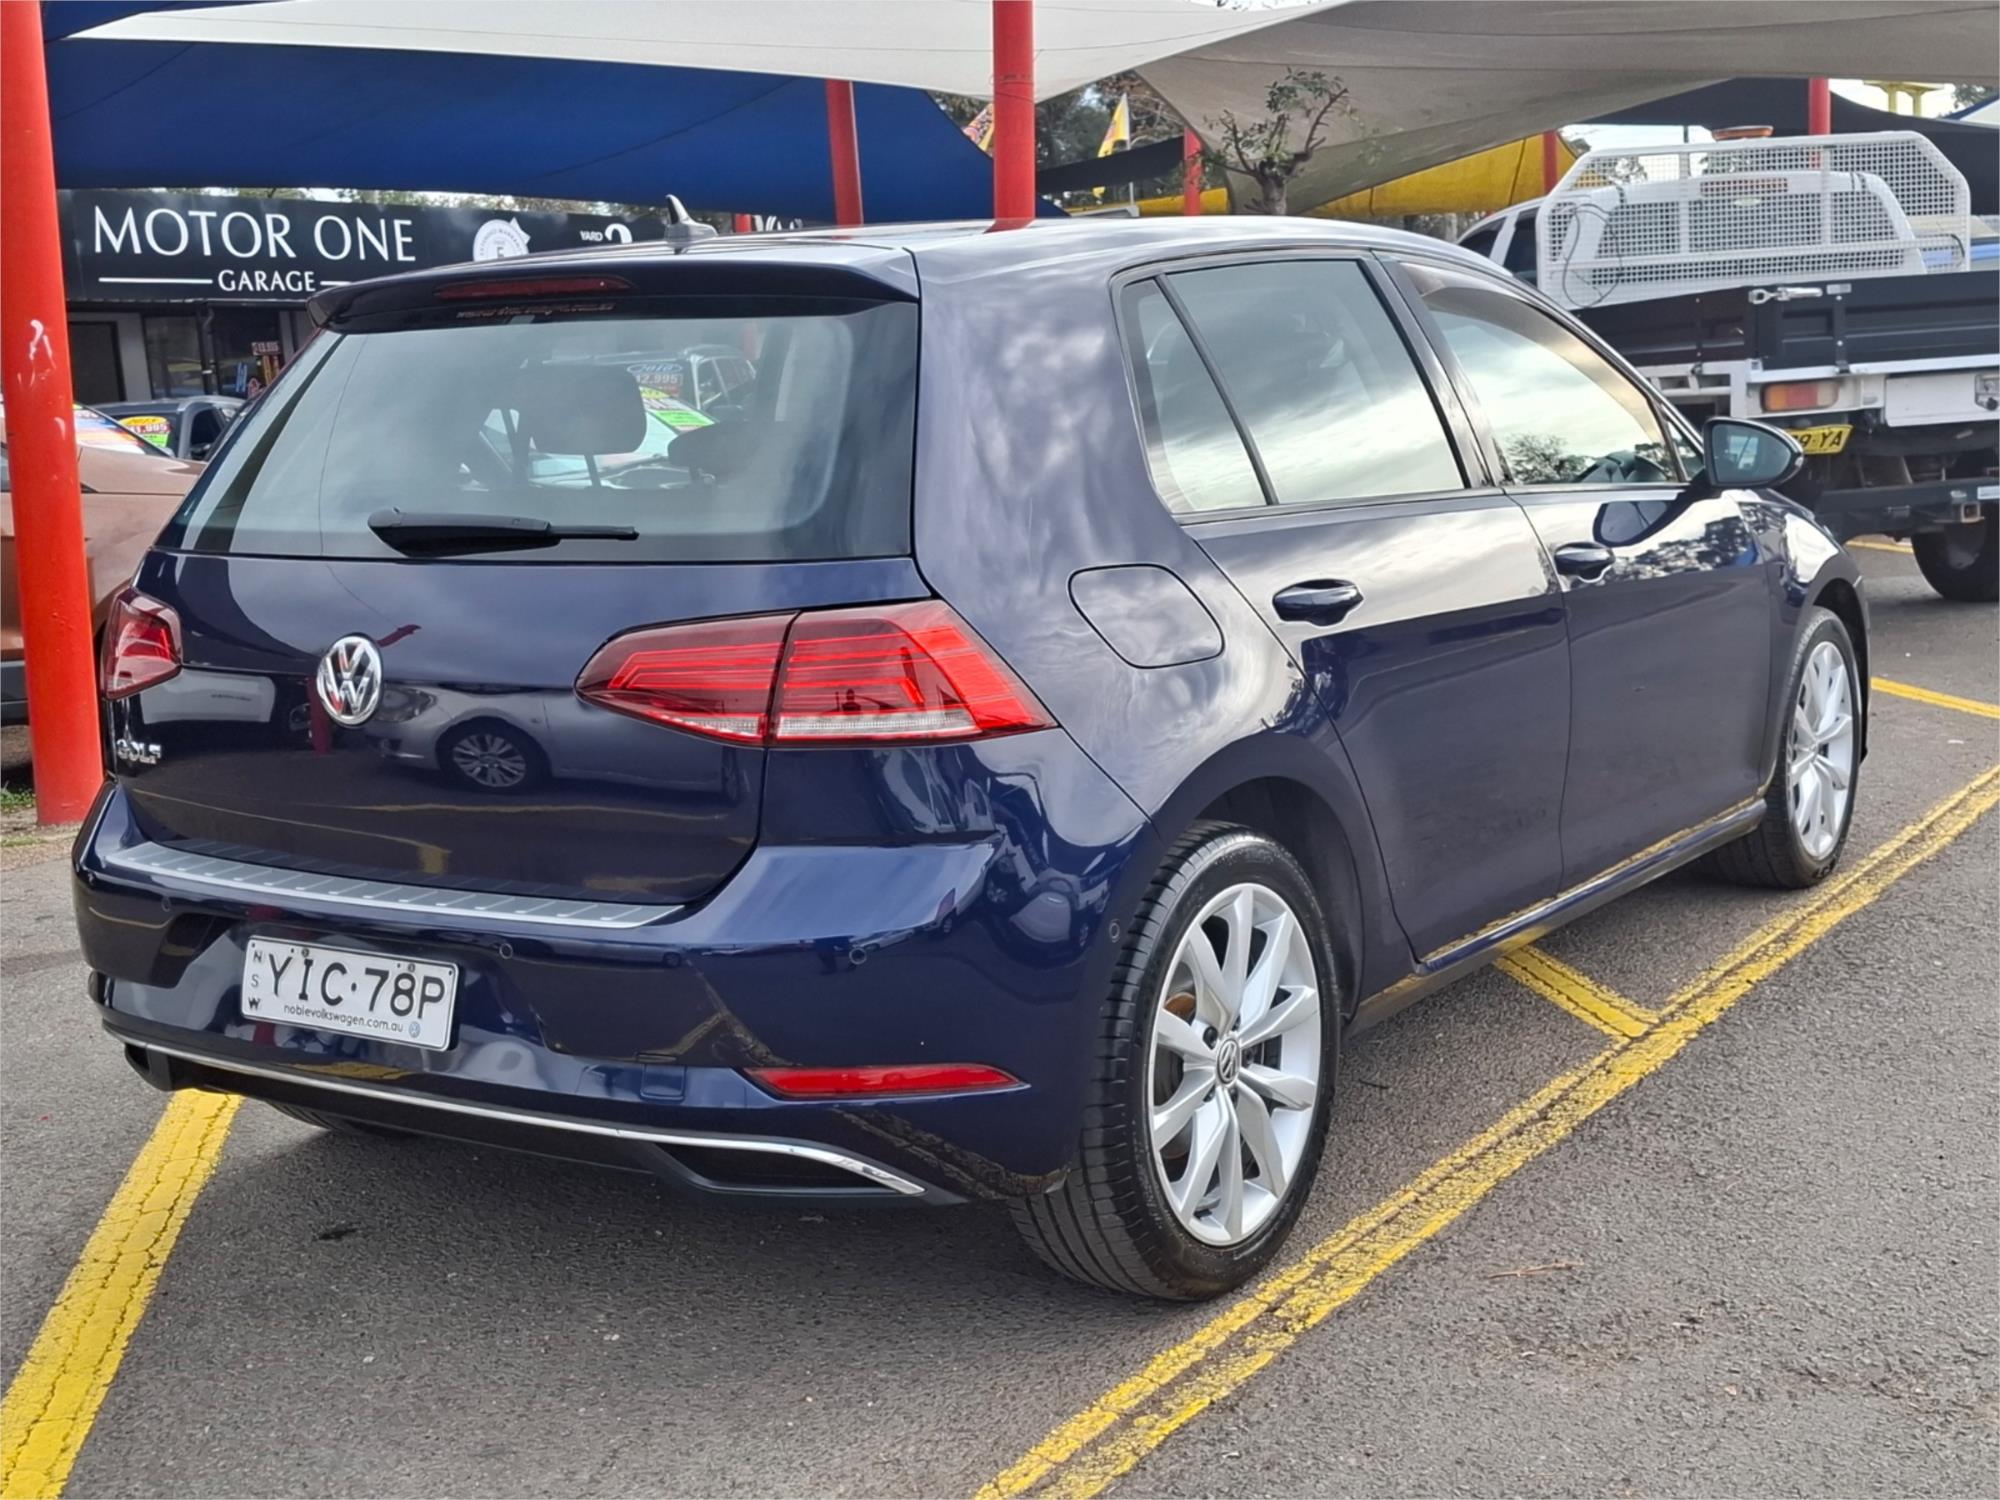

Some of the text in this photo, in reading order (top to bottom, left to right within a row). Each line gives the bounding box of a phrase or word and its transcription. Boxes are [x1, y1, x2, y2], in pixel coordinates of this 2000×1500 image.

[94, 205, 416, 262] MOTOR ONE
[579, 230, 604, 243] YARD
[217, 269, 316, 293] GARAGE
[116, 738, 162, 765] GOLF
[283, 1003, 404, 1034] noblevolkswagen.com.au
